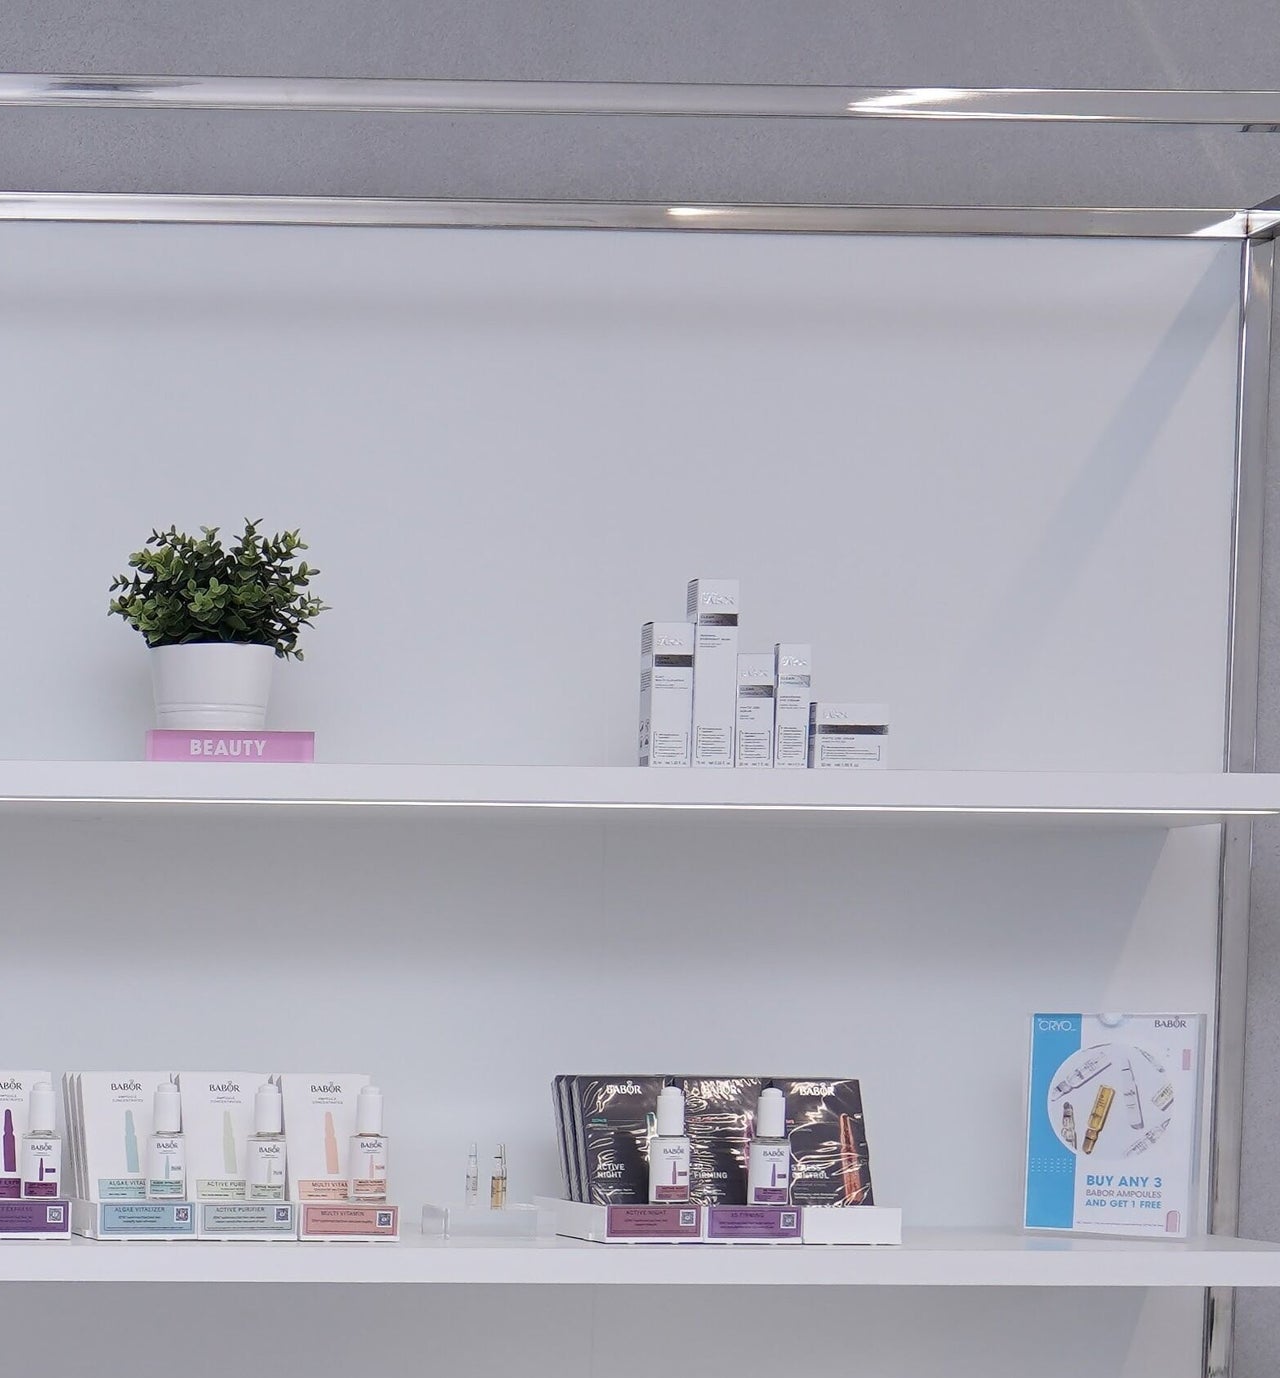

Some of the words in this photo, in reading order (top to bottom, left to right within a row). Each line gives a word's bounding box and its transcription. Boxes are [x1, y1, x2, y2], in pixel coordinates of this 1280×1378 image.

[191, 740, 266, 756] BEAUTY
[1087, 1175, 1113, 1186] BUY
[1118, 1176, 1148, 1187] ANY
[1154, 1177, 1162, 1187] 3
[1086, 1189, 1114, 1197] BABOR
[1116, 1190, 1161, 1198] AMPOULES
[1110, 1200, 1129, 1208] GET
